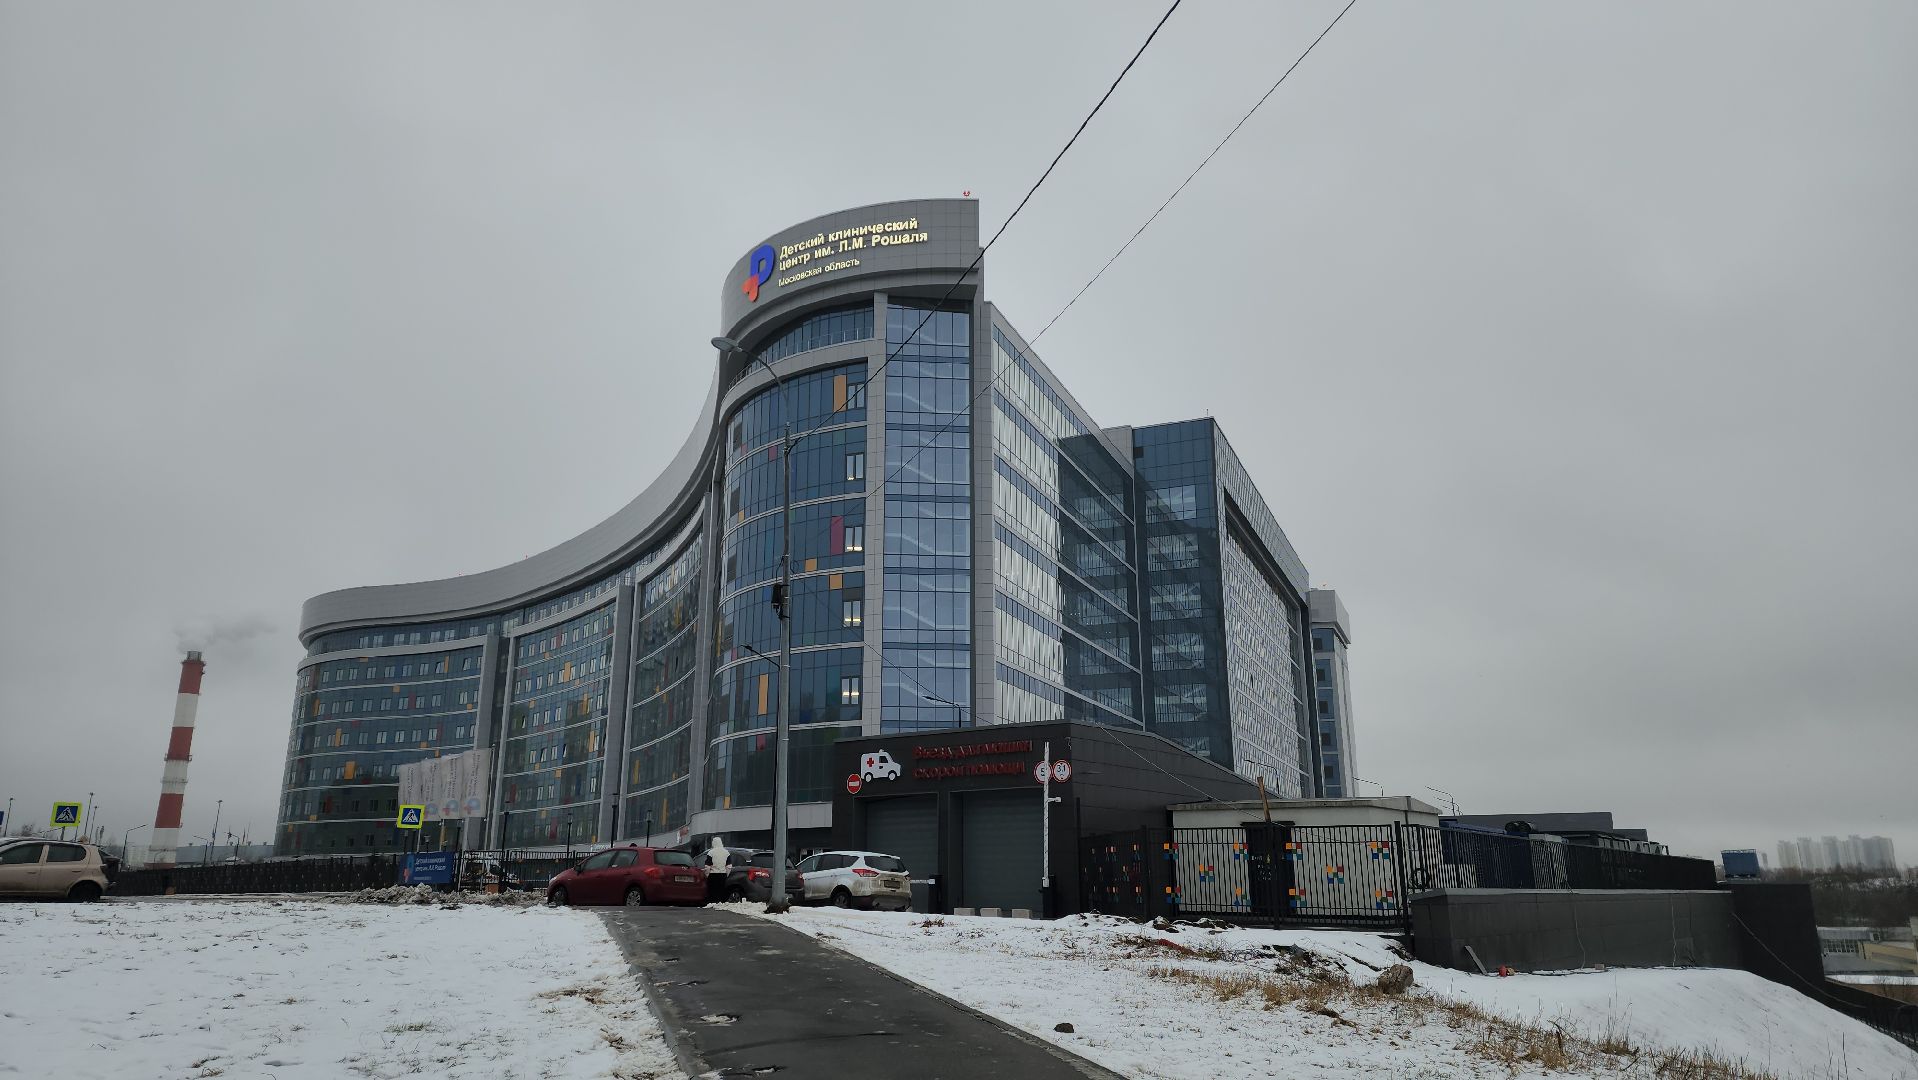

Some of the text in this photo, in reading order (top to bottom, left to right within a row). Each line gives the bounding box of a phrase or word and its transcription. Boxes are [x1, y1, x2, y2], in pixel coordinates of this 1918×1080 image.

[779, 252, 811, 271] центр
[814, 245, 835, 259] им.
[871, 231, 928, 247] Рошаля
[780, 218, 918, 260] Детский клинический
[778, 257, 860, 288] Московская область
